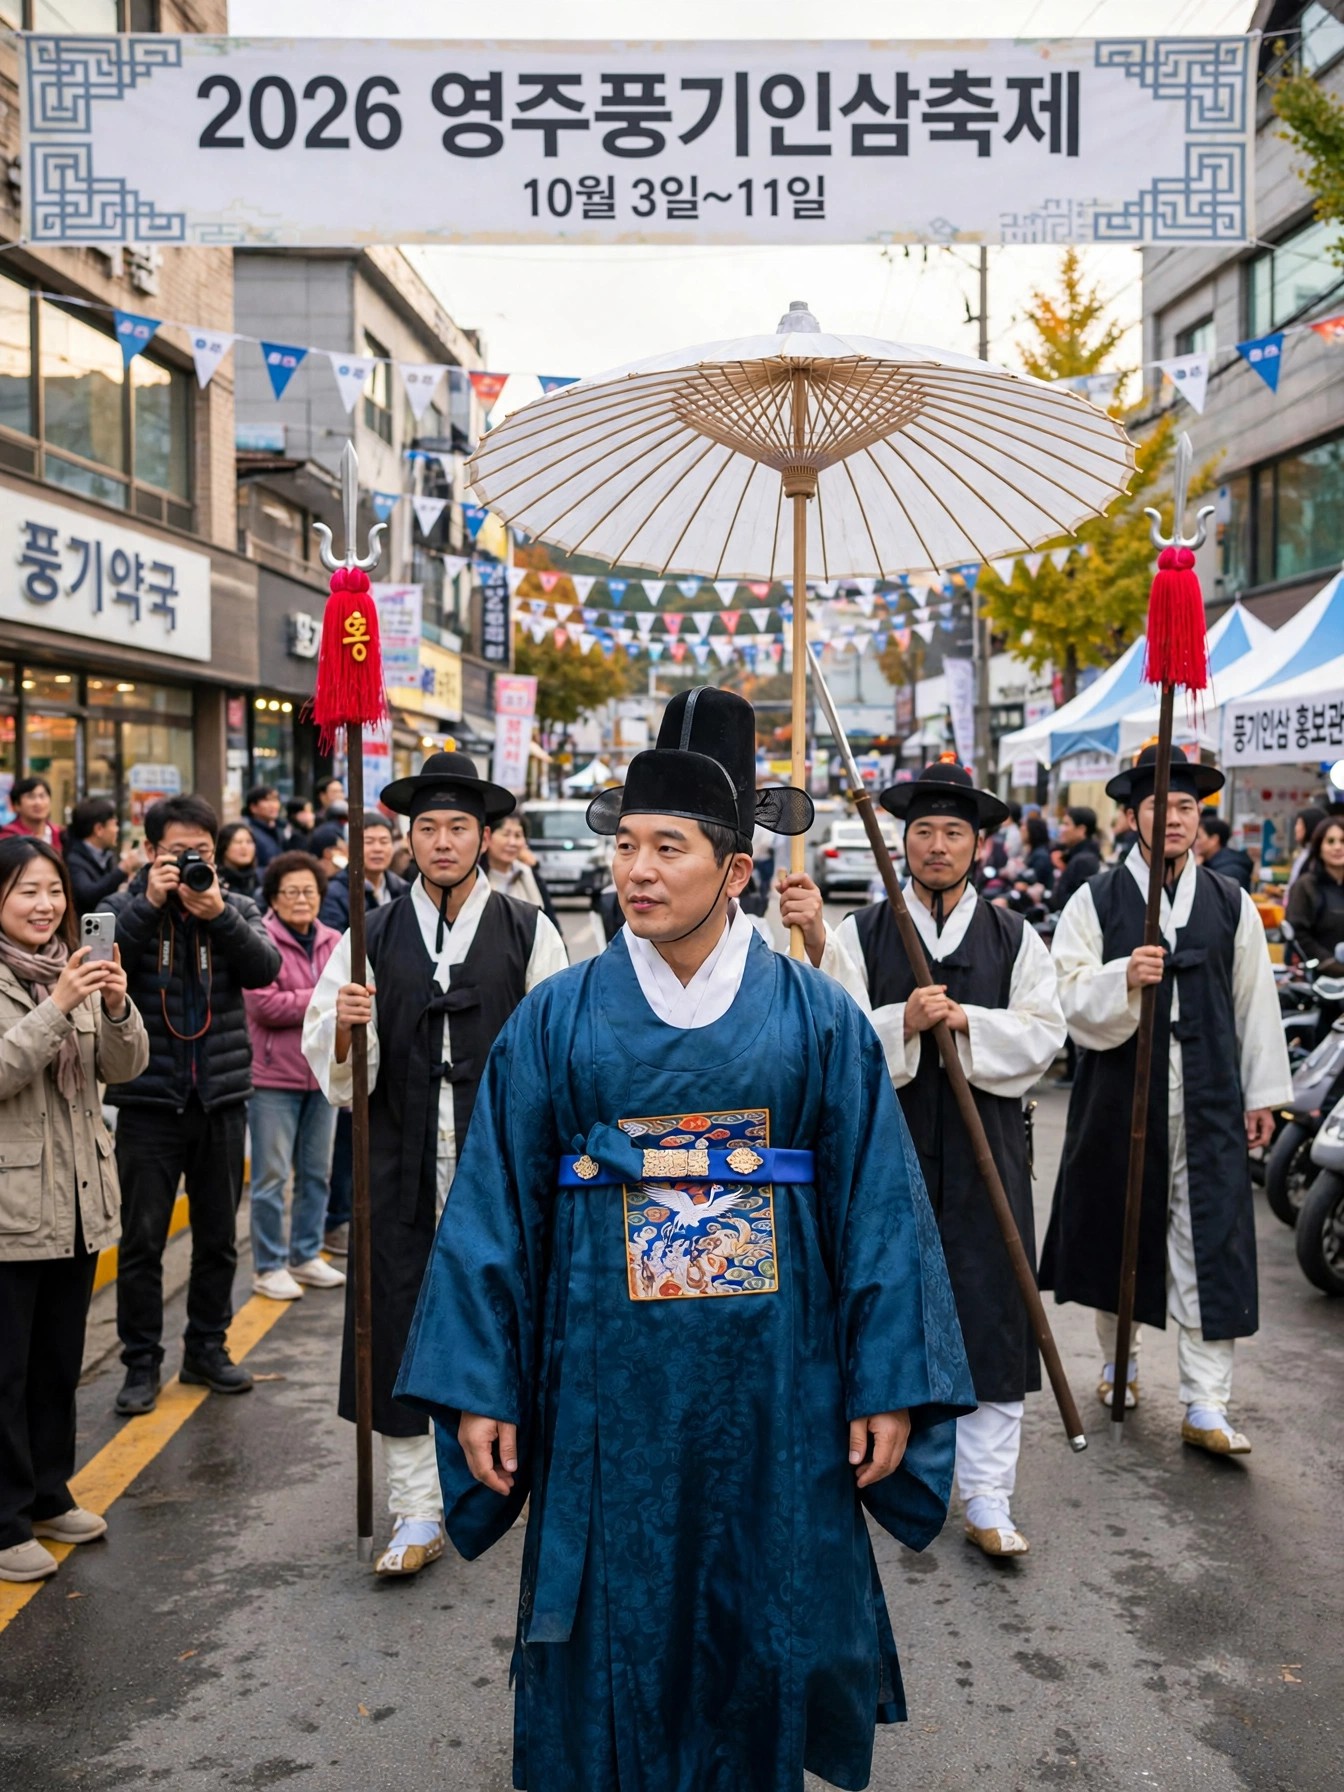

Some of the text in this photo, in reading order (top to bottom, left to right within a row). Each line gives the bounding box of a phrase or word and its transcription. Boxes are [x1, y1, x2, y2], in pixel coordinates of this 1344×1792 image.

[196, 69, 1080, 159] 2026 영주풍기인삼축제
[524, 175, 826, 220] 10월 3일~11일
[21, 520, 179, 631] 풍기약국
[1233, 700, 1344, 753] 풍기인삼 홍보관
